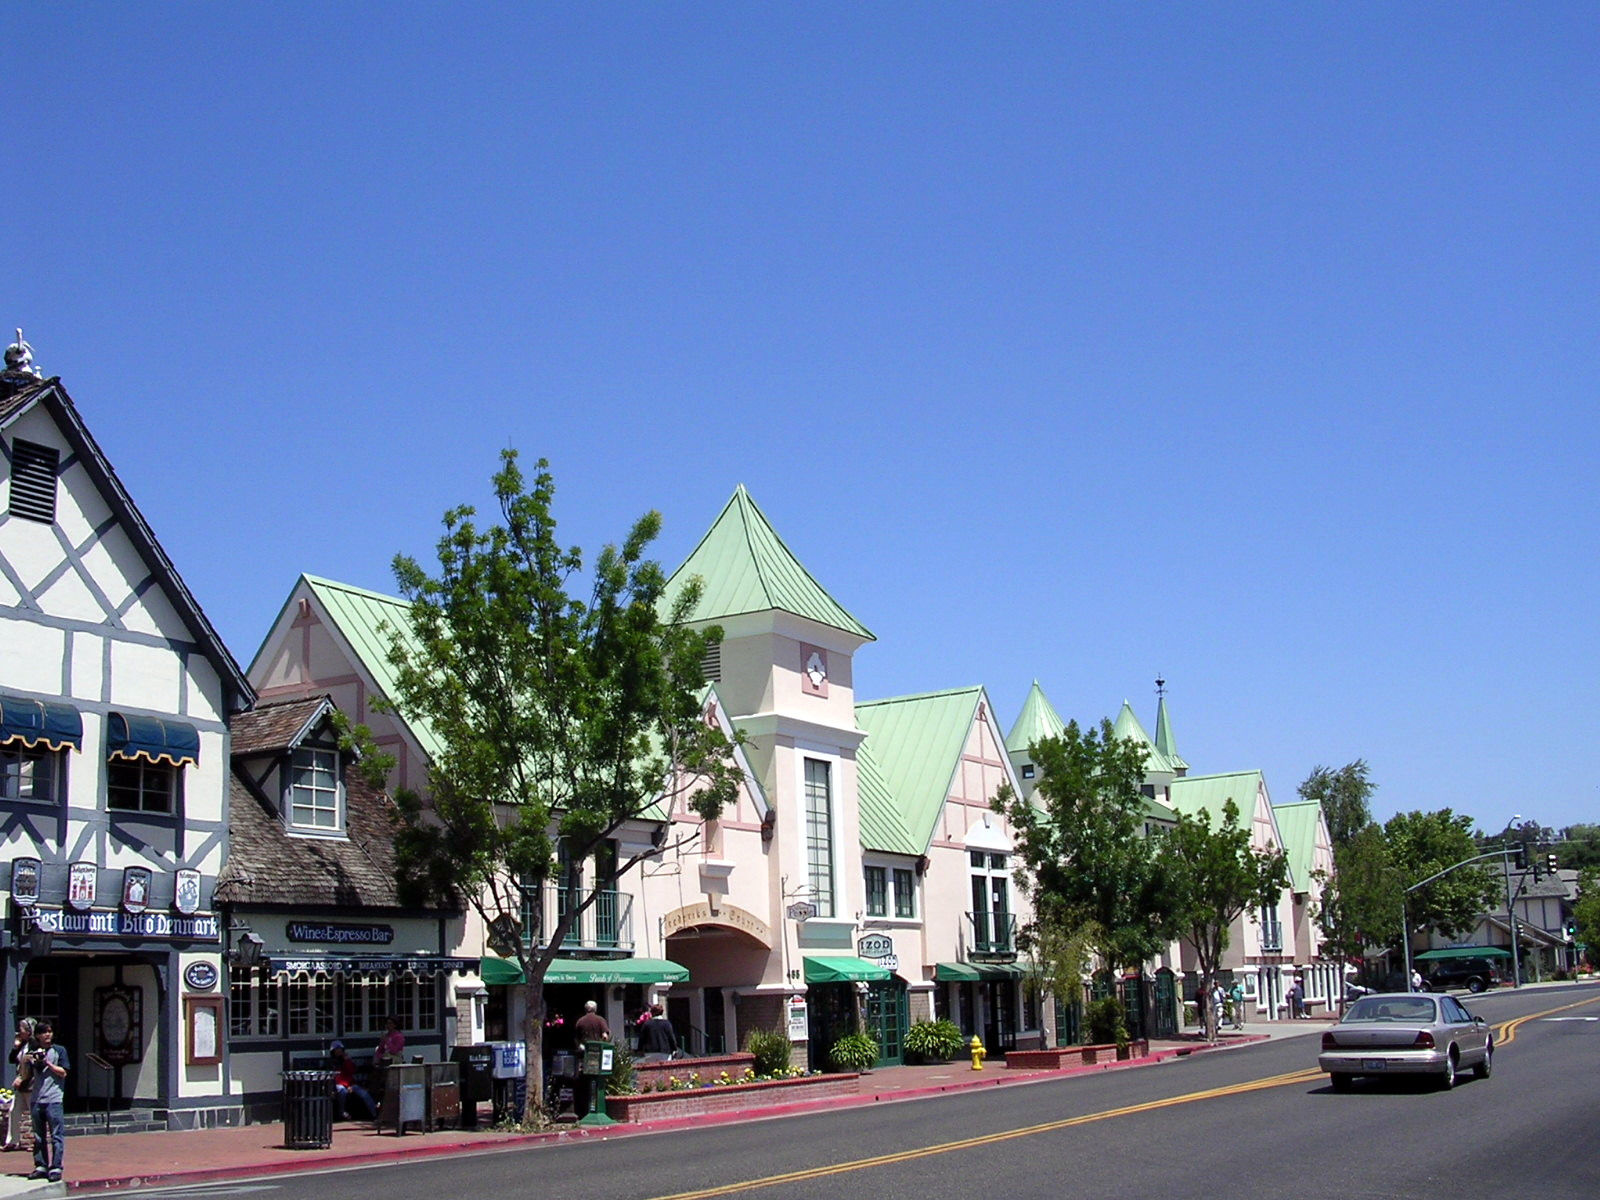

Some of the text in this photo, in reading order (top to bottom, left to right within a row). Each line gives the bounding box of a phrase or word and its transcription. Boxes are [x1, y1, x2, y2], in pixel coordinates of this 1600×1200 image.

[31, 908, 115, 932] Restaurant
[121, 913, 144, 934] Bit
[156, 914, 218, 936] Denmark
[372, 928, 390, 941] Bar
[860, 940, 890, 950] IZOD
[443, 961, 464, 969] DINNER
